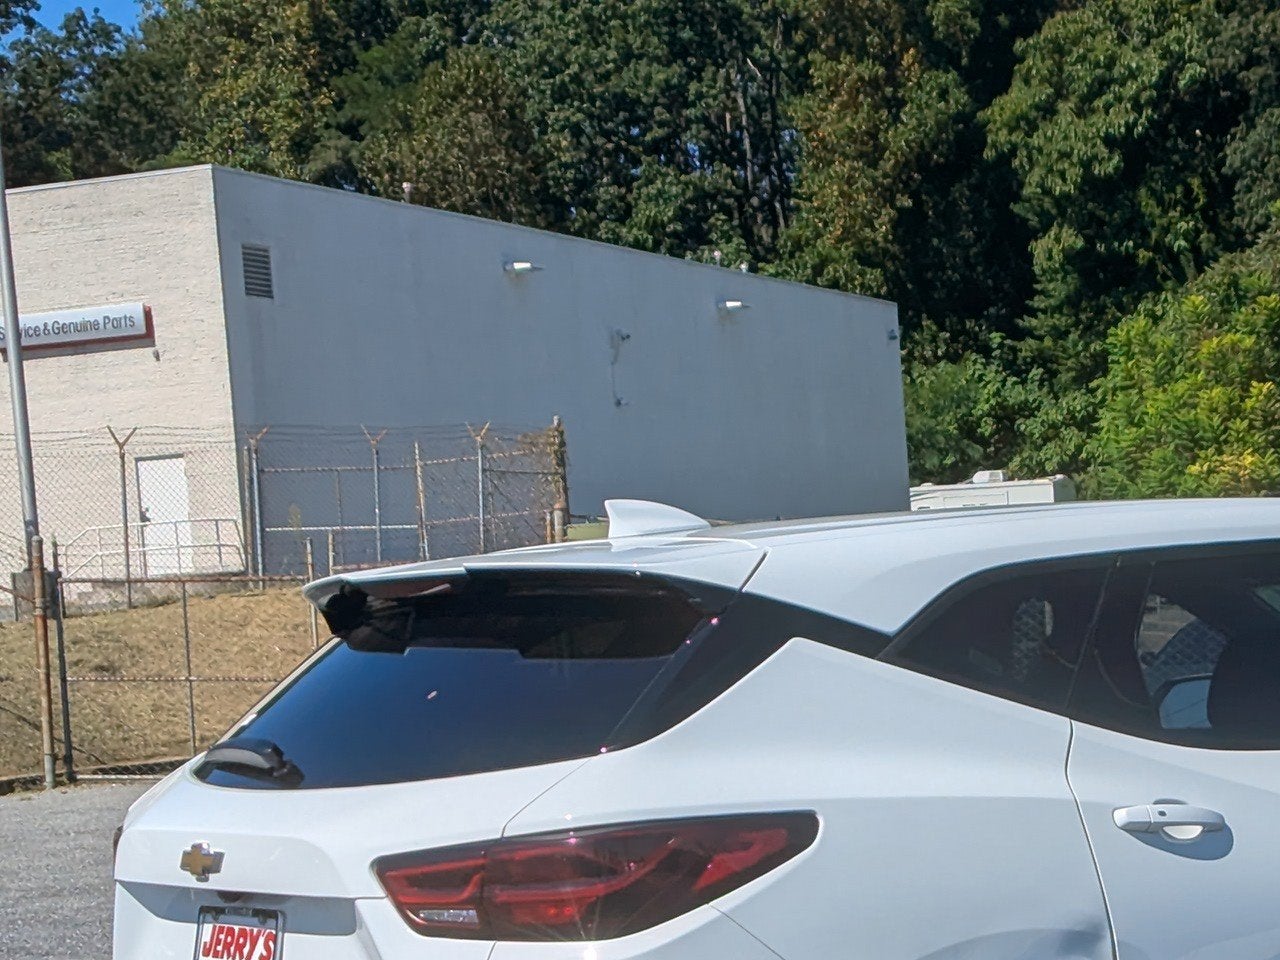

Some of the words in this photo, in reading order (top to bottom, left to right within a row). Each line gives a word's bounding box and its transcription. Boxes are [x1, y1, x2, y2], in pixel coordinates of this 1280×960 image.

[43, 321, 51, 336] &
[51, 317, 100, 336] Genuine
[103, 313, 136, 330] Parts
